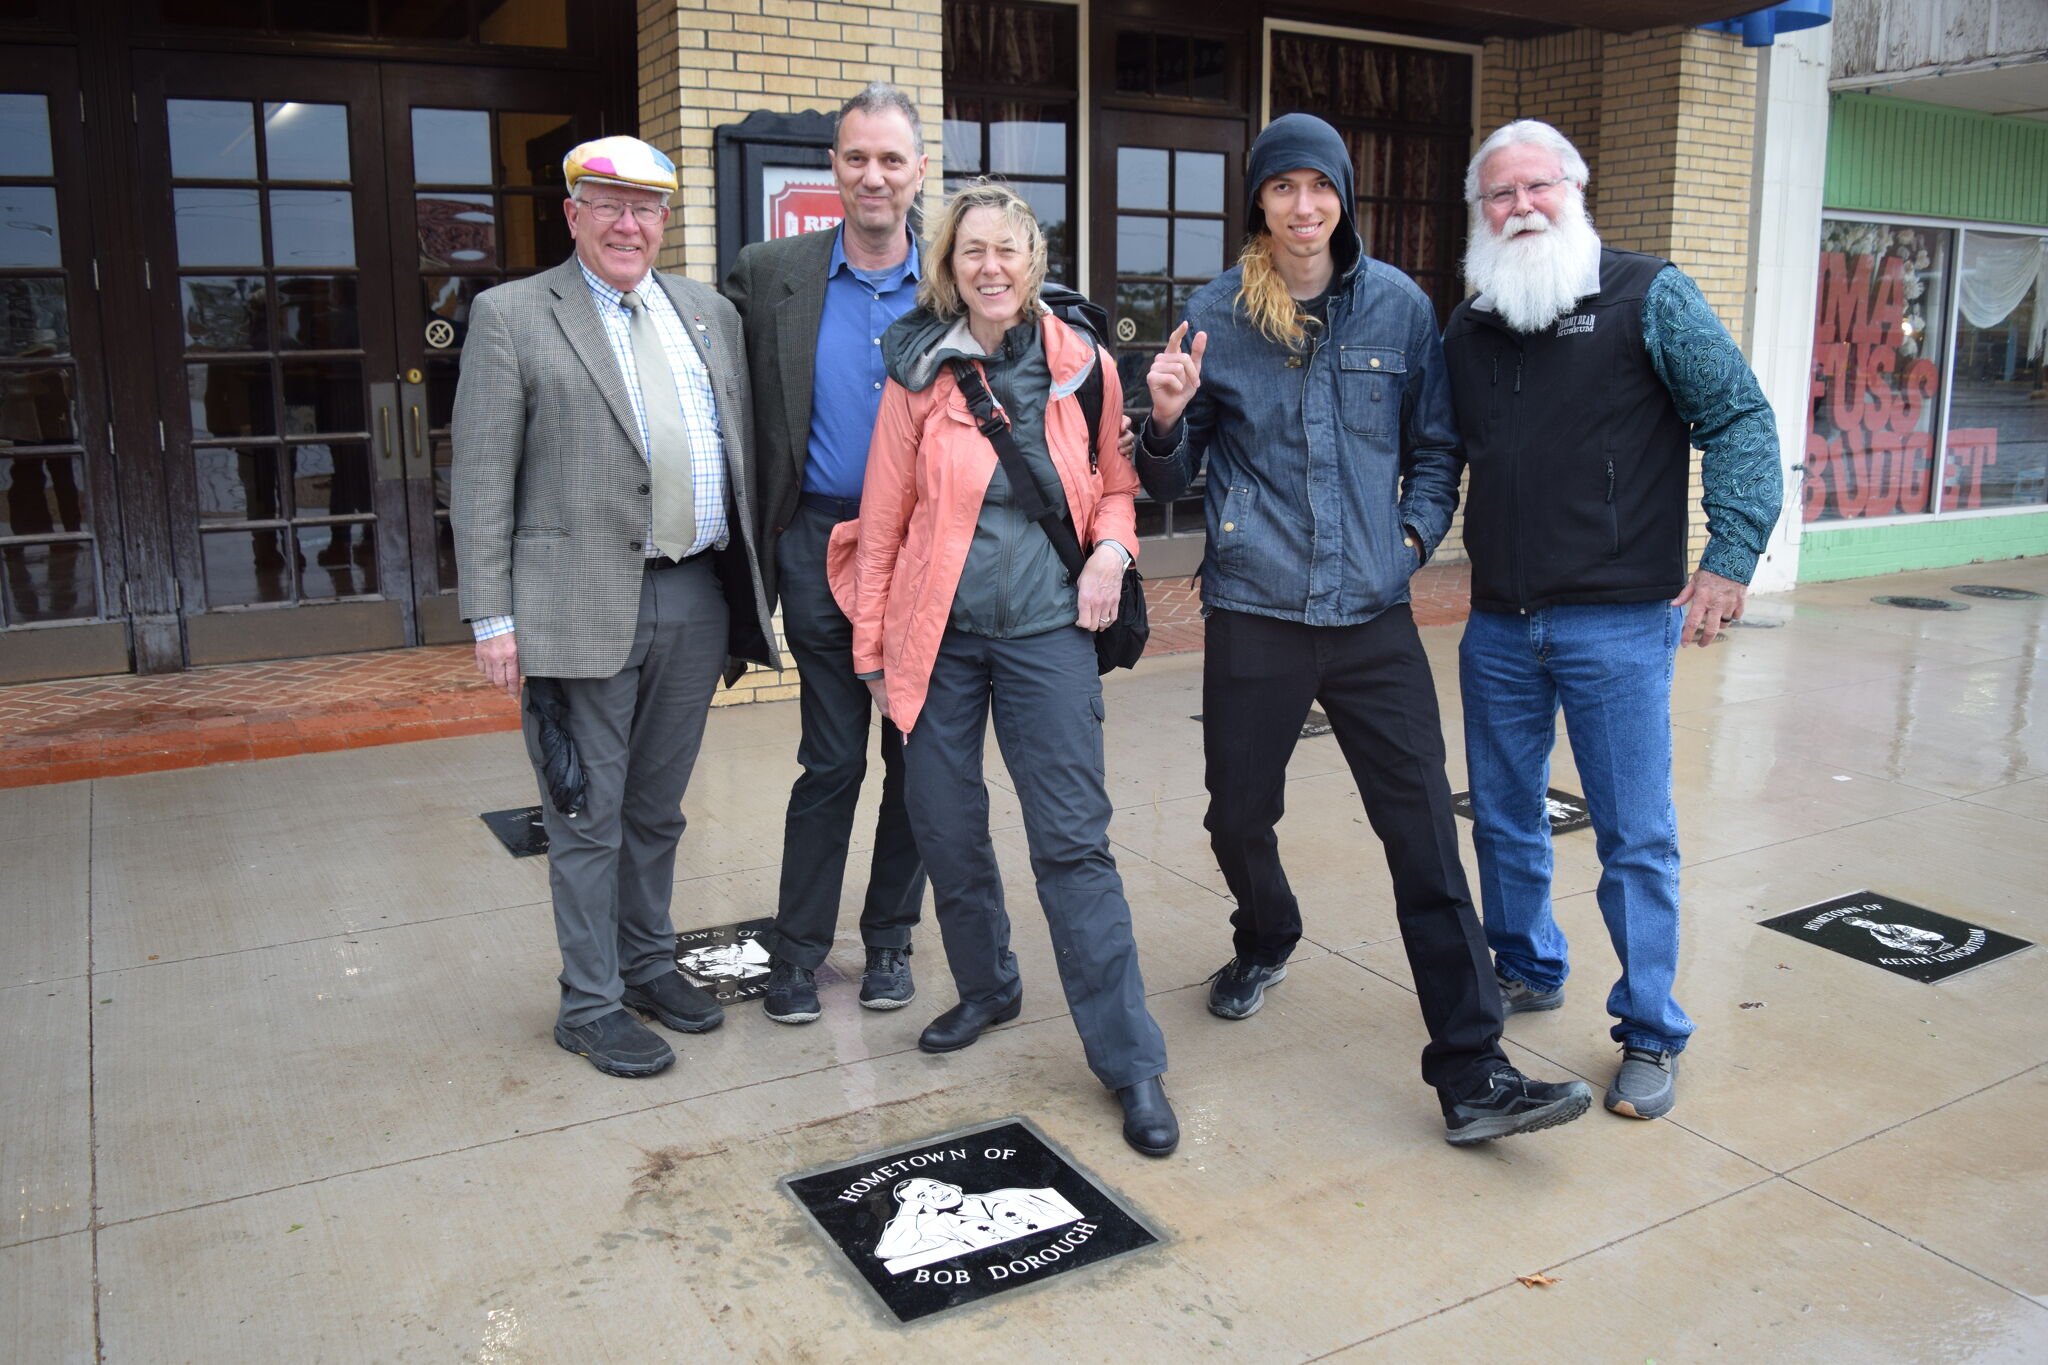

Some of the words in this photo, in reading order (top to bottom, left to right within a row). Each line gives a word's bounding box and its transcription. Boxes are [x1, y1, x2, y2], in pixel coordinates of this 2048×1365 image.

[1556, 326, 1595, 338] MUSEUM
[1806, 343, 1939, 436] FUSS
[1802, 426, 1998, 523] BUDGET
[737, 930, 763, 938] OF
[1803, 906, 1863, 931] HOMETOWN
[1862, 903, 1883, 911] OF
[1878, 957, 1934, 965] KEITH
[838, 1149, 967, 1203] HOMETOWN
[983, 1148, 1017, 1161] OF
[913, 1269, 971, 1285] BOB
[987, 1221, 1098, 1280] DOROUGH
